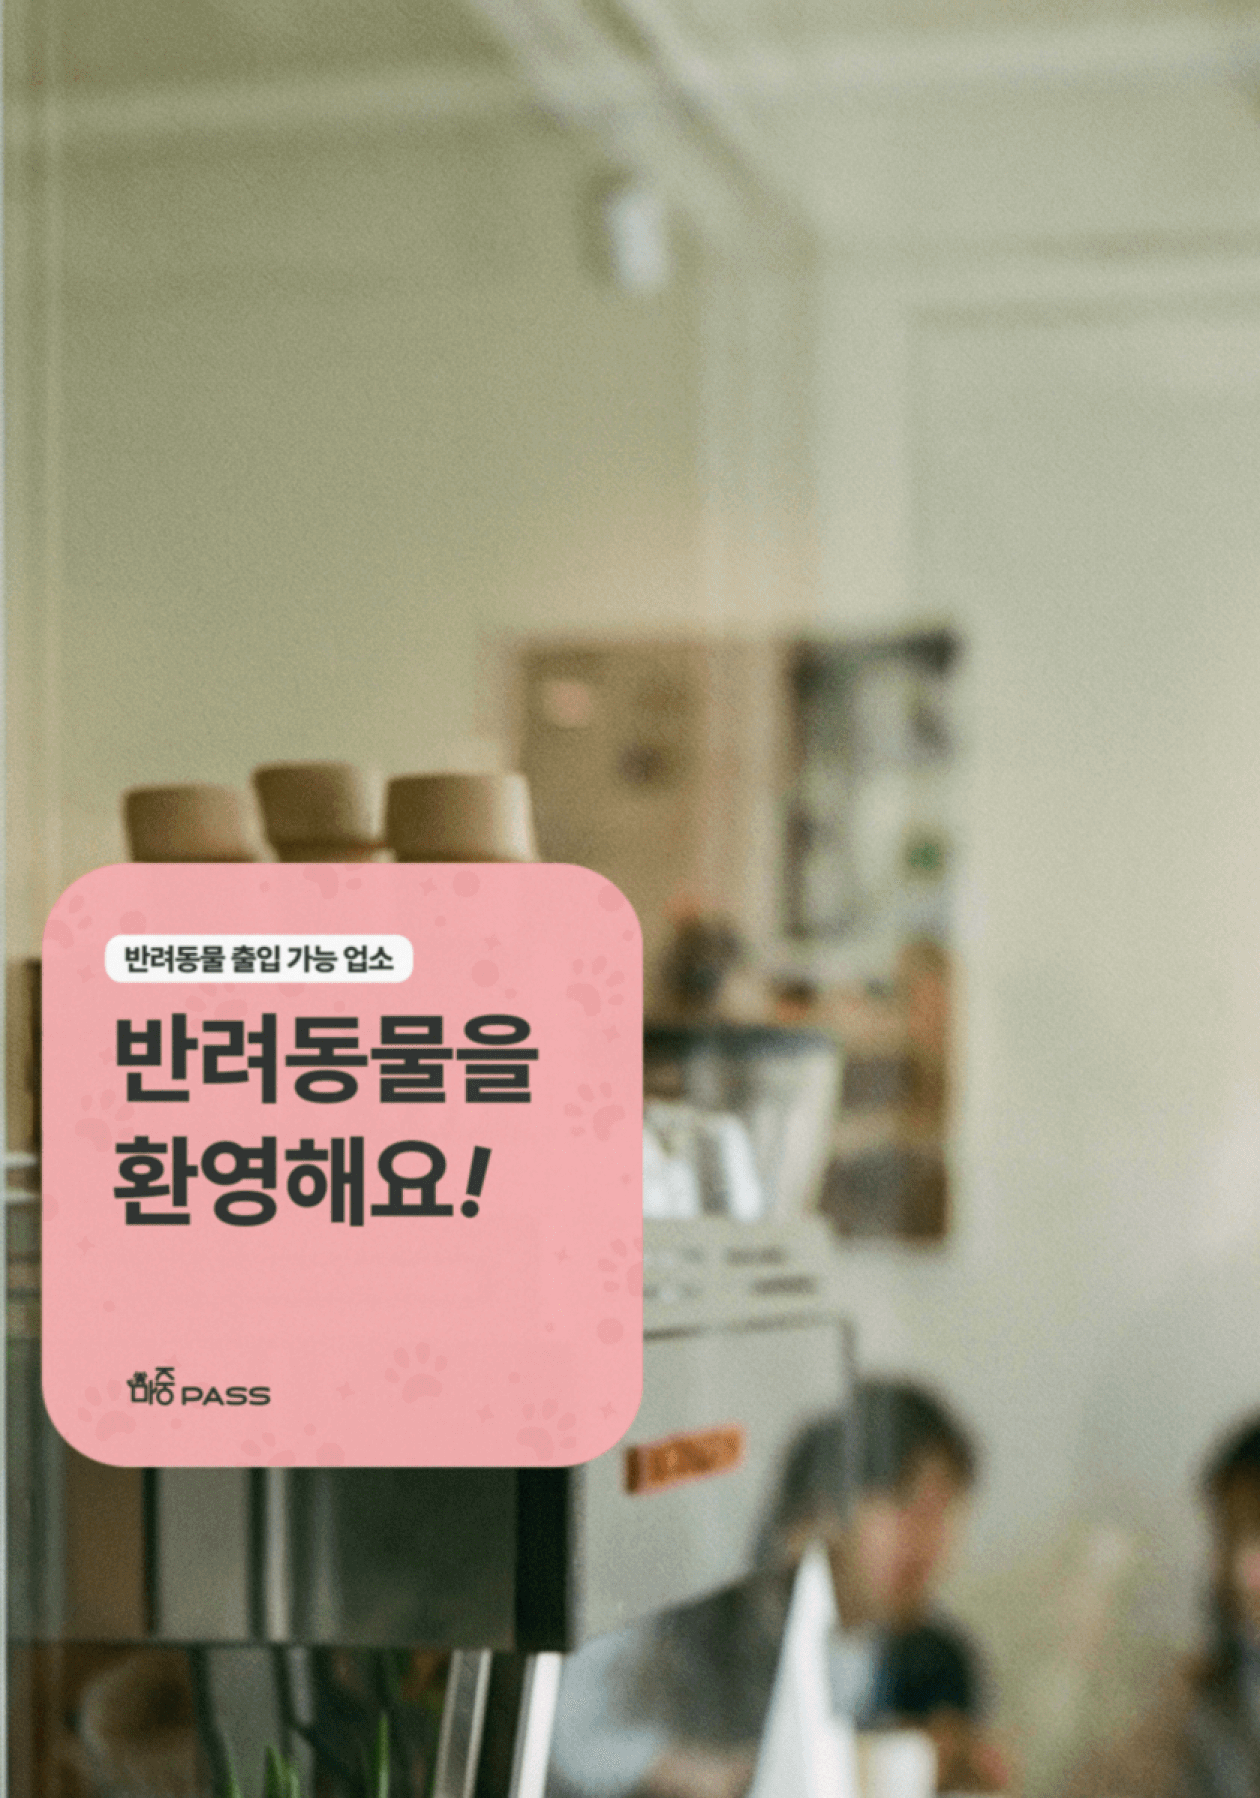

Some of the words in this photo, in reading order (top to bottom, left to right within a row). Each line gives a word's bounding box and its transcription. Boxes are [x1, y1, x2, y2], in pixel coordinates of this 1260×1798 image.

[125, 944, 226, 973] 반려동물
[231, 944, 280, 973] 출입
[287, 944, 338, 973] 가능
[343, 944, 394, 973] 업소
[116, 1012, 539, 1104] 반려동물을
[113, 1135, 492, 1227] 환영해요!
[181, 1386, 271, 1406] PASS
